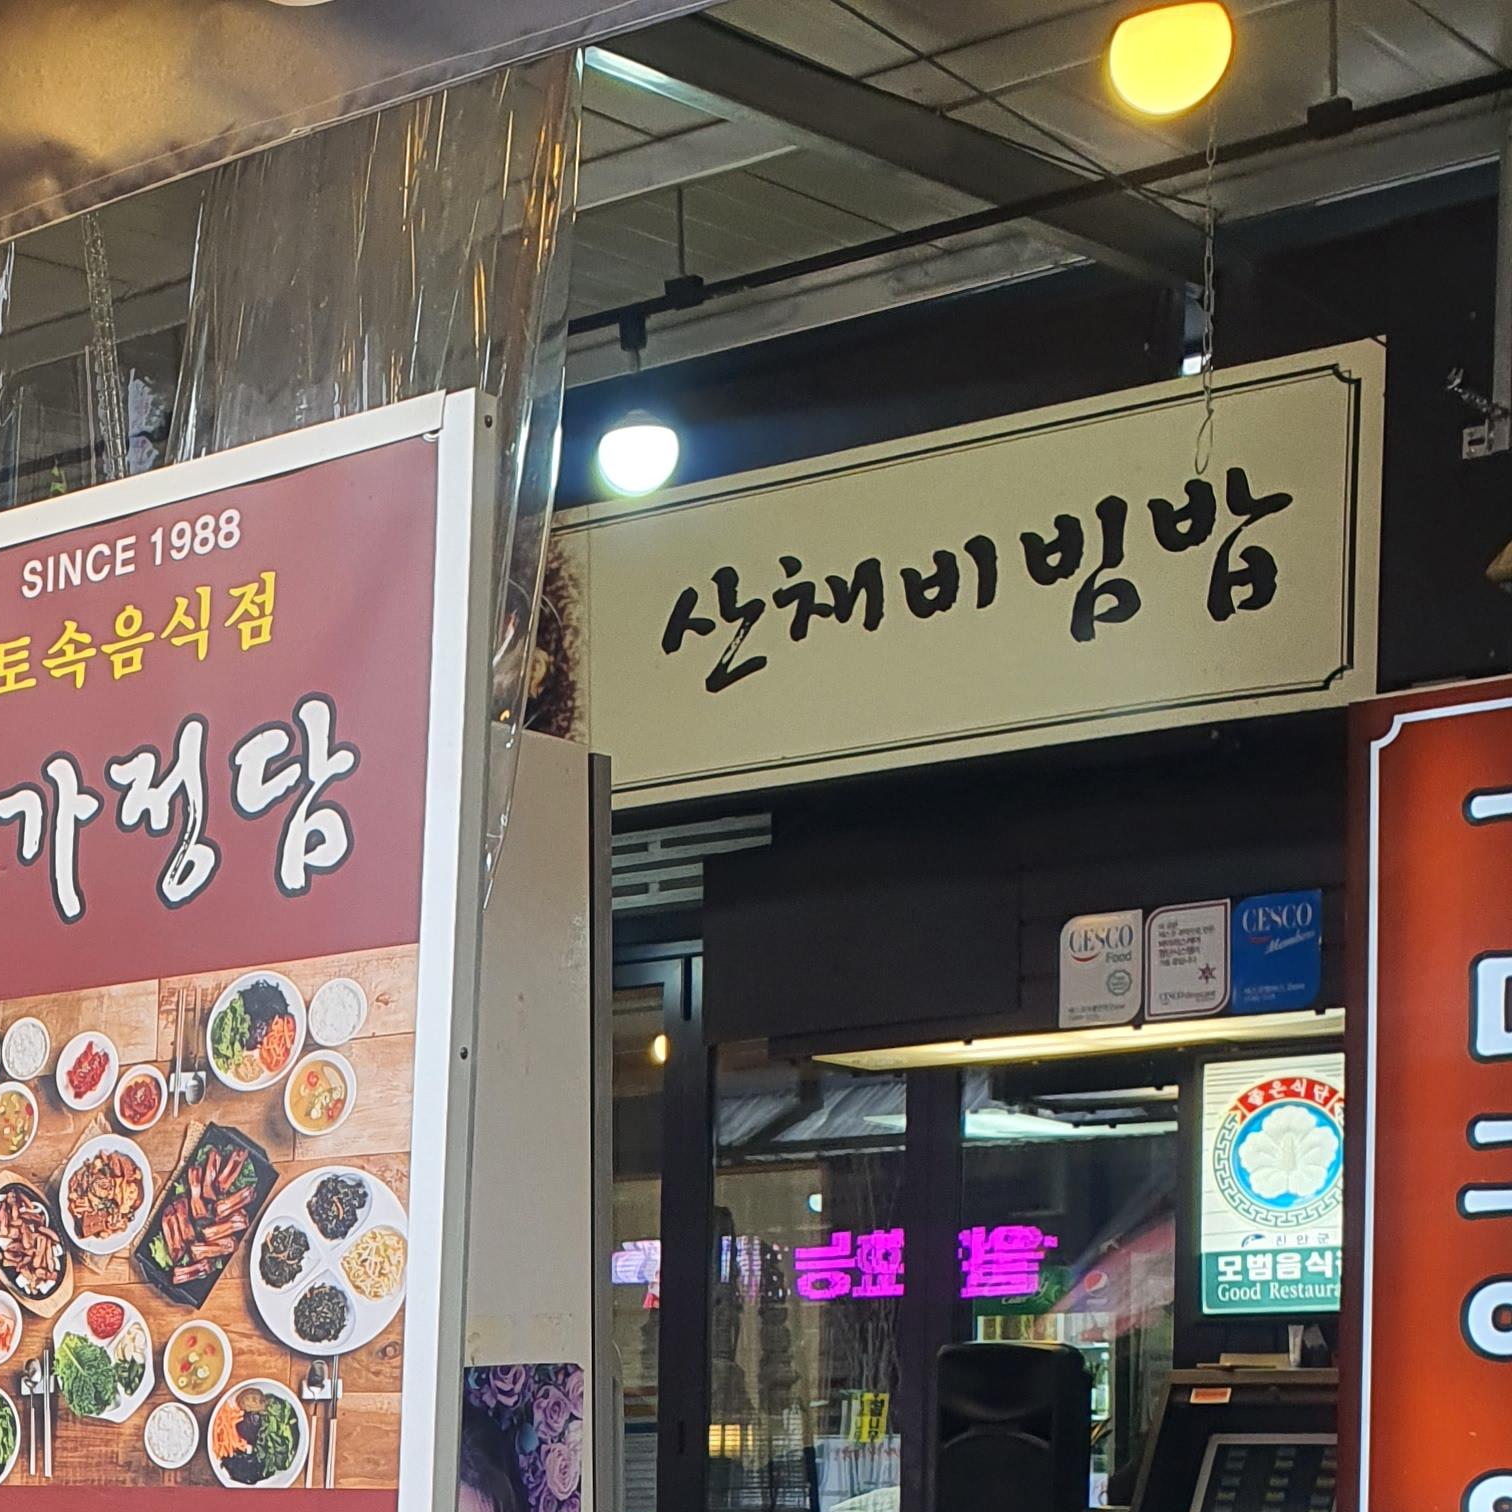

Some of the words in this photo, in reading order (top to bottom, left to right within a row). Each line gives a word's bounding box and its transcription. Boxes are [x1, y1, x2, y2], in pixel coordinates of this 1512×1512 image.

[21, 536, 136, 599] SINCE
[150, 509, 241, 566] 1988
[660, 465, 1293, 694] 산채비빔밥
[1242, 903, 1312, 933] CESCO
[1069, 924, 1133, 954] CESCO
[1105, 952, 1132, 964] Food
[1218, 1252, 1342, 1281] 모범음식
[1217, 1284, 1261, 1301] Good
